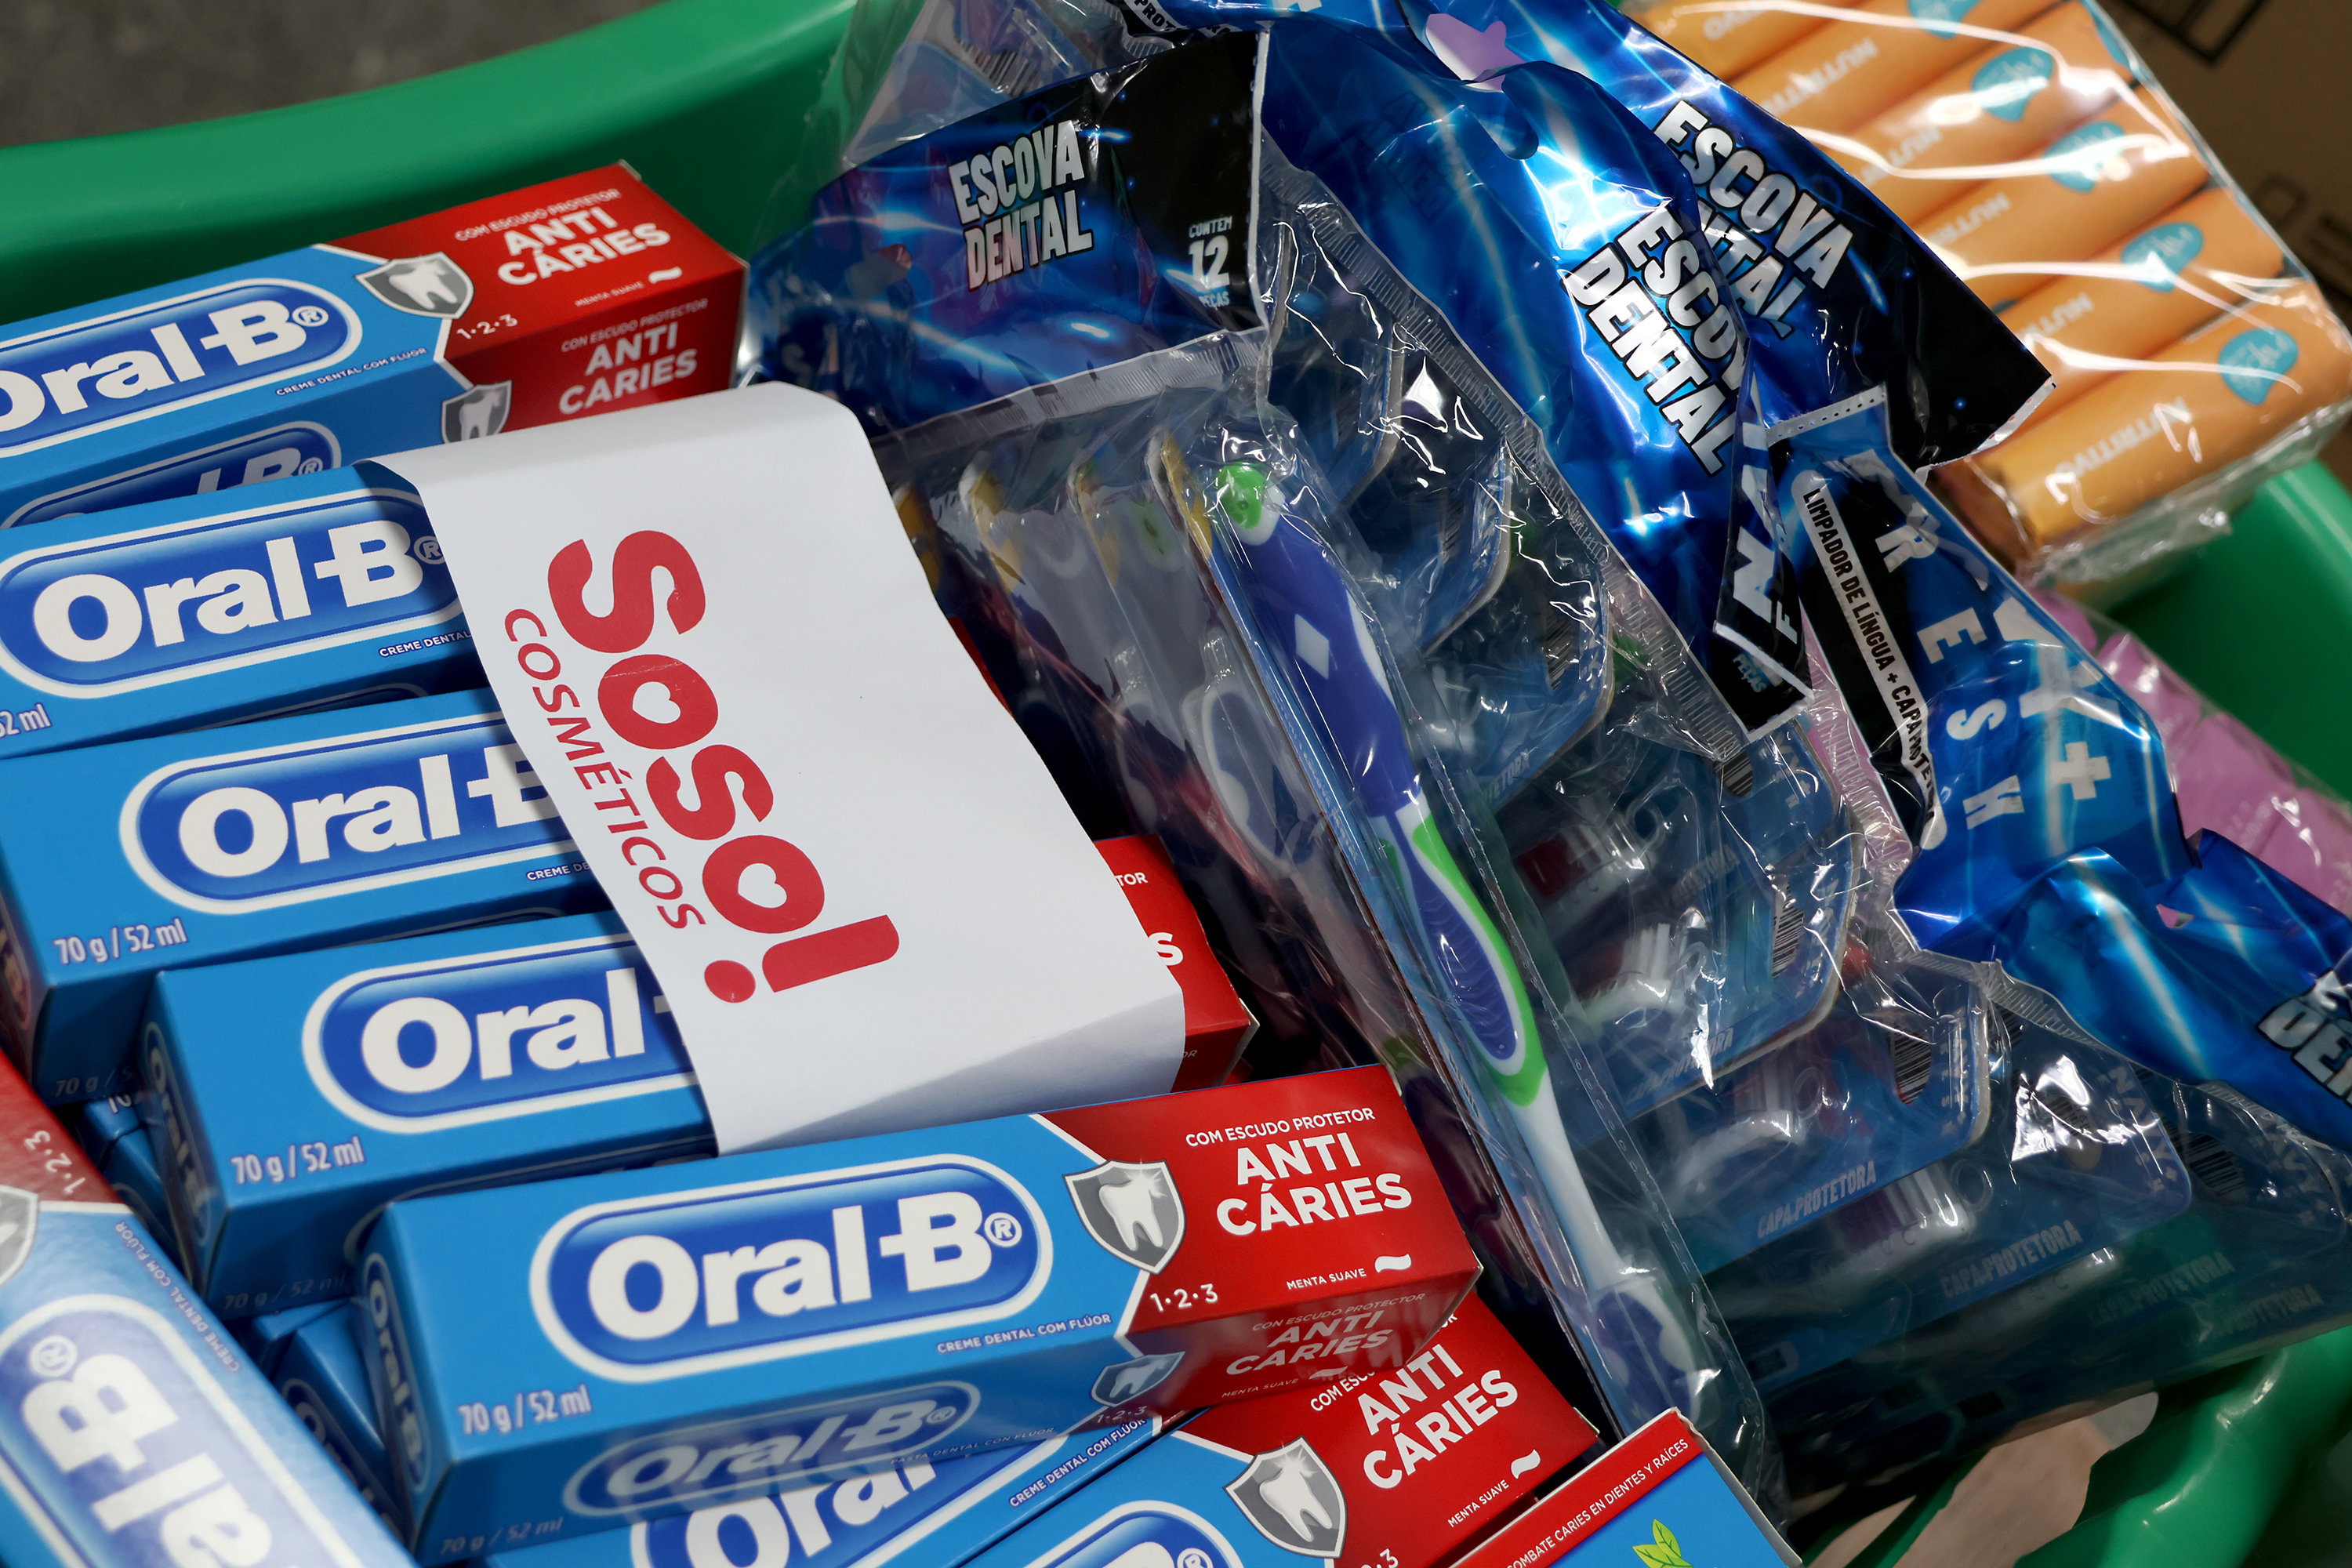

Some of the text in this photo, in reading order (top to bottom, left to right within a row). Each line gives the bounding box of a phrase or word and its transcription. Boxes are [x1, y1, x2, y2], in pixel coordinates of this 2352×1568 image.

[949, 120, 1084, 225] ESCOVA
[1654, 100, 1853, 289] ESCOVA
[503, 206, 618, 256] ANTI
[964, 191, 1092, 291] DENTAL
[1189, 235, 1230, 289] 12
[584, 321, 679, 376] ANTI
[1563, 243, 1735, 474] DENTAL
[276, 379, 316, 396] CREME
[317, 366, 362, 384] DENTAL
[362, 358, 389, 371] COM
[559, 349, 698, 415] CARIES
[1802, 488, 1853, 579] LIMPADOR
[1840, 575, 1866, 605] DE
[379, 630, 472, 657] CREME DENTAL
[1852, 610, 1896, 672] LÍNGUA
[18, 702, 52, 731] ml
[504, 608, 706, 929] COSMÉTICOS
[527, 865, 572, 881] CREME
[54, 935, 85, 967] 70
[89, 936, 108, 966] g
[124, 925, 155, 955] 52
[154, 917, 189, 949] ml
[1185, 1107, 1376, 1147] COM ESCUDO PROTETOR
[232, 1156, 264, 1185] 70
[266, 1157, 285, 1183] g
[302, 1142, 332, 1173] 52
[334, 1135, 365, 1166] ml
[1237, 1132, 1362, 1185] ANTI
[1216, 1172, 1412, 1236] CÁRIES
[146, 1260, 172, 1287] COM
[1287, 1268, 1367, 1290] MENTA SUAVE
[170, 1287, 209, 1333] DENTAL
[937, 1313, 1112, 1355] CREME DENTAL COM FLÚOR
[1252, 1293, 1426, 1331] CON ESCUDO PROTECTOR
[1267, 1310, 1385, 1348] ANTI
[204, 1331, 240, 1372] CREME
[1226, 1328, 1393, 1376] CARIES
[459, 1406, 490, 1436] 70
[493, 1406, 512, 1432] g
[528, 1392, 556, 1421] 52
[557, 1385, 592, 1415] ml
[1310, 1385, 1343, 1412] COM
[1358, 1343, 1464, 1436] ANTI
[931, 1443, 979, 1458] DENTAL
[984, 1436, 1011, 1446] CON
[1363, 1368, 1519, 1490] CÁRIES
[1009, 1417, 1146, 1507] CREME DENTAL COM FLÚOR
[1447, 1479, 1510, 1528] MENTA SUAVE
[1555, 1510, 1591, 1541] CARIES
[1591, 1498, 1606, 1515] EN
[1606, 1469, 1646, 1504] DIENTES
[1643, 1463, 1653, 1475] Y
[1653, 1438, 1689, 1469] RAÍCES
